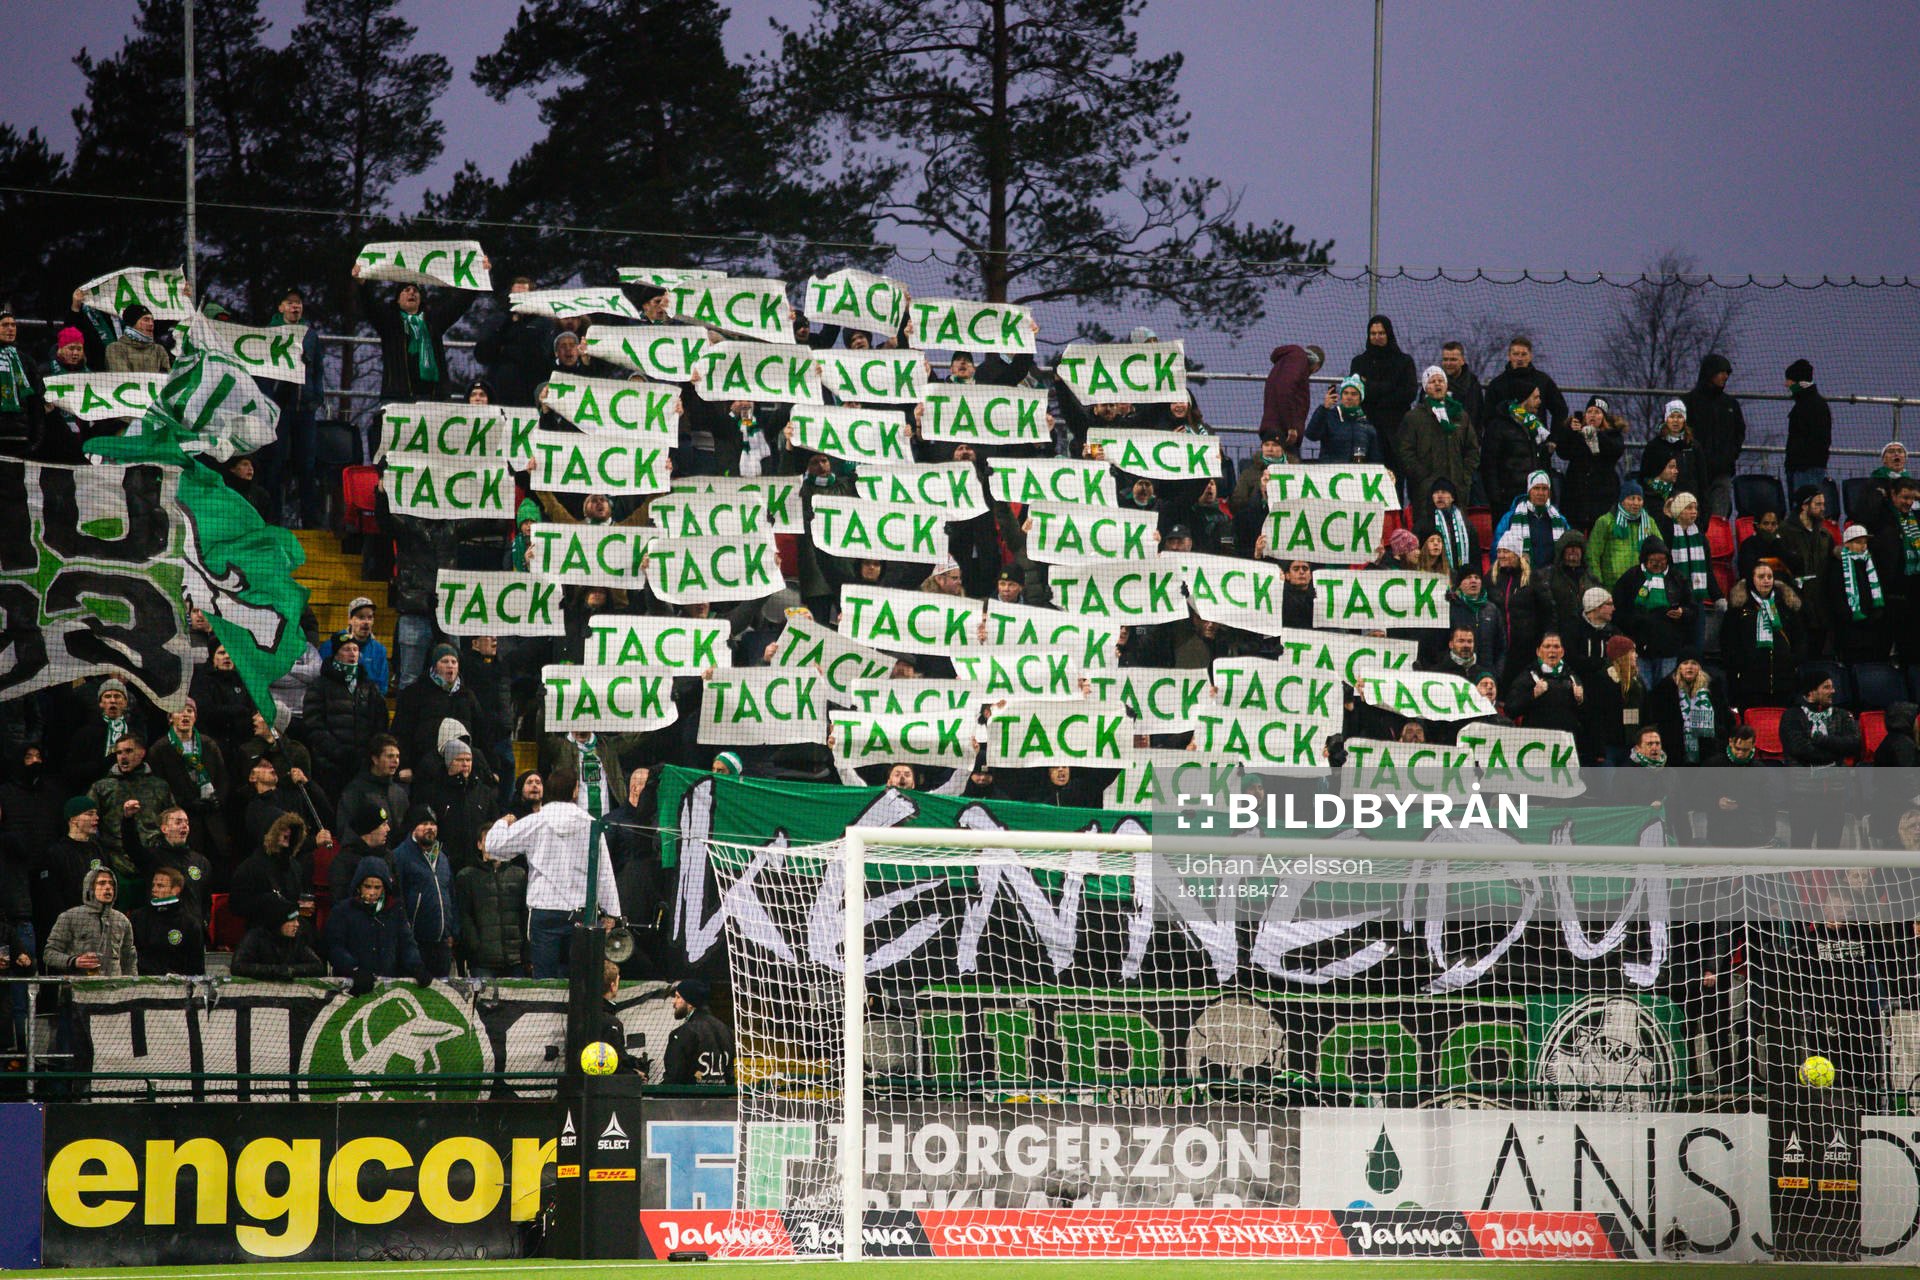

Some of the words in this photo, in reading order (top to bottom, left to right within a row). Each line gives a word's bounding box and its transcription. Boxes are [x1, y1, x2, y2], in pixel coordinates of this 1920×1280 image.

[511, 295, 632, 318] ACK
[672, 288, 783, 332] TACK
[811, 277, 902, 328] TACK
[175, 324, 295, 369] TCK
[913, 303, 1025, 347] TACK
[586, 337, 705, 376] ACK
[702, 352, 813, 398] TACK
[816, 359, 917, 398] ACK
[1060, 352, 1178, 395] TACK
[47, 382, 157, 413] TAC
[548, 382, 673, 432] TACK
[925, 394, 1040, 439] TACK
[386, 415, 497, 456] TACK
[791, 415, 904, 459] TACK
[388, 465, 505, 510] TACK
[536, 442, 661, 489] TACK
[991, 467, 1109, 505] TACK
[856, 469, 975, 508] TACK
[1270, 473, 1388, 507] TACK
[652, 502, 762, 537] TACK
[814, 507, 937, 555] TACK
[1030, 510, 1146, 559] TACK
[1269, 510, 1375, 553] TACK
[534, 532, 658, 577] TACK
[648, 543, 771, 593] TACK
[439, 581, 556, 625] TACK
[1051, 571, 1175, 617] TACK
[1182, 566, 1274, 614] ACK
[1316, 577, 1439, 619] TACK
[846, 597, 972, 646] TACK
[591, 626, 720, 667] TACK
[779, 626, 889, 693] TACK
[955, 654, 1071, 695] TACK
[1216, 669, 1333, 717] TACK
[1363, 678, 1482, 715] TACK
[545, 676, 665, 721] TACK
[707, 677, 817, 723] TACK
[1091, 675, 1207, 720] TACK
[834, 718, 963, 759] TACK
[992, 713, 1123, 759] TACK
[1198, 715, 1319, 766] TACK
[1348, 746, 1468, 794] TACK
[1461, 736, 1574, 787] TACK
[598, 1140, 630, 1150] SELECT
[1783, 1154, 1804, 1163] SELECT
[1824, 1152, 1851, 1161] SELECT
[596, 1171, 629, 1179] DHL
[659, 1222, 774, 1249] Jahwa
[800, 1221, 913, 1249] Jawa
[944, 1225, 1021, 1245] GOTT
[1026, 1225, 1121, 1244] KAFFE
[1134, 1225, 1211, 1244] HELT
[1215, 1224, 1325, 1244] ENKELT
[1352, 1222, 1462, 1250] Jahwa
[1485, 1223, 1595, 1250] Jahwa
